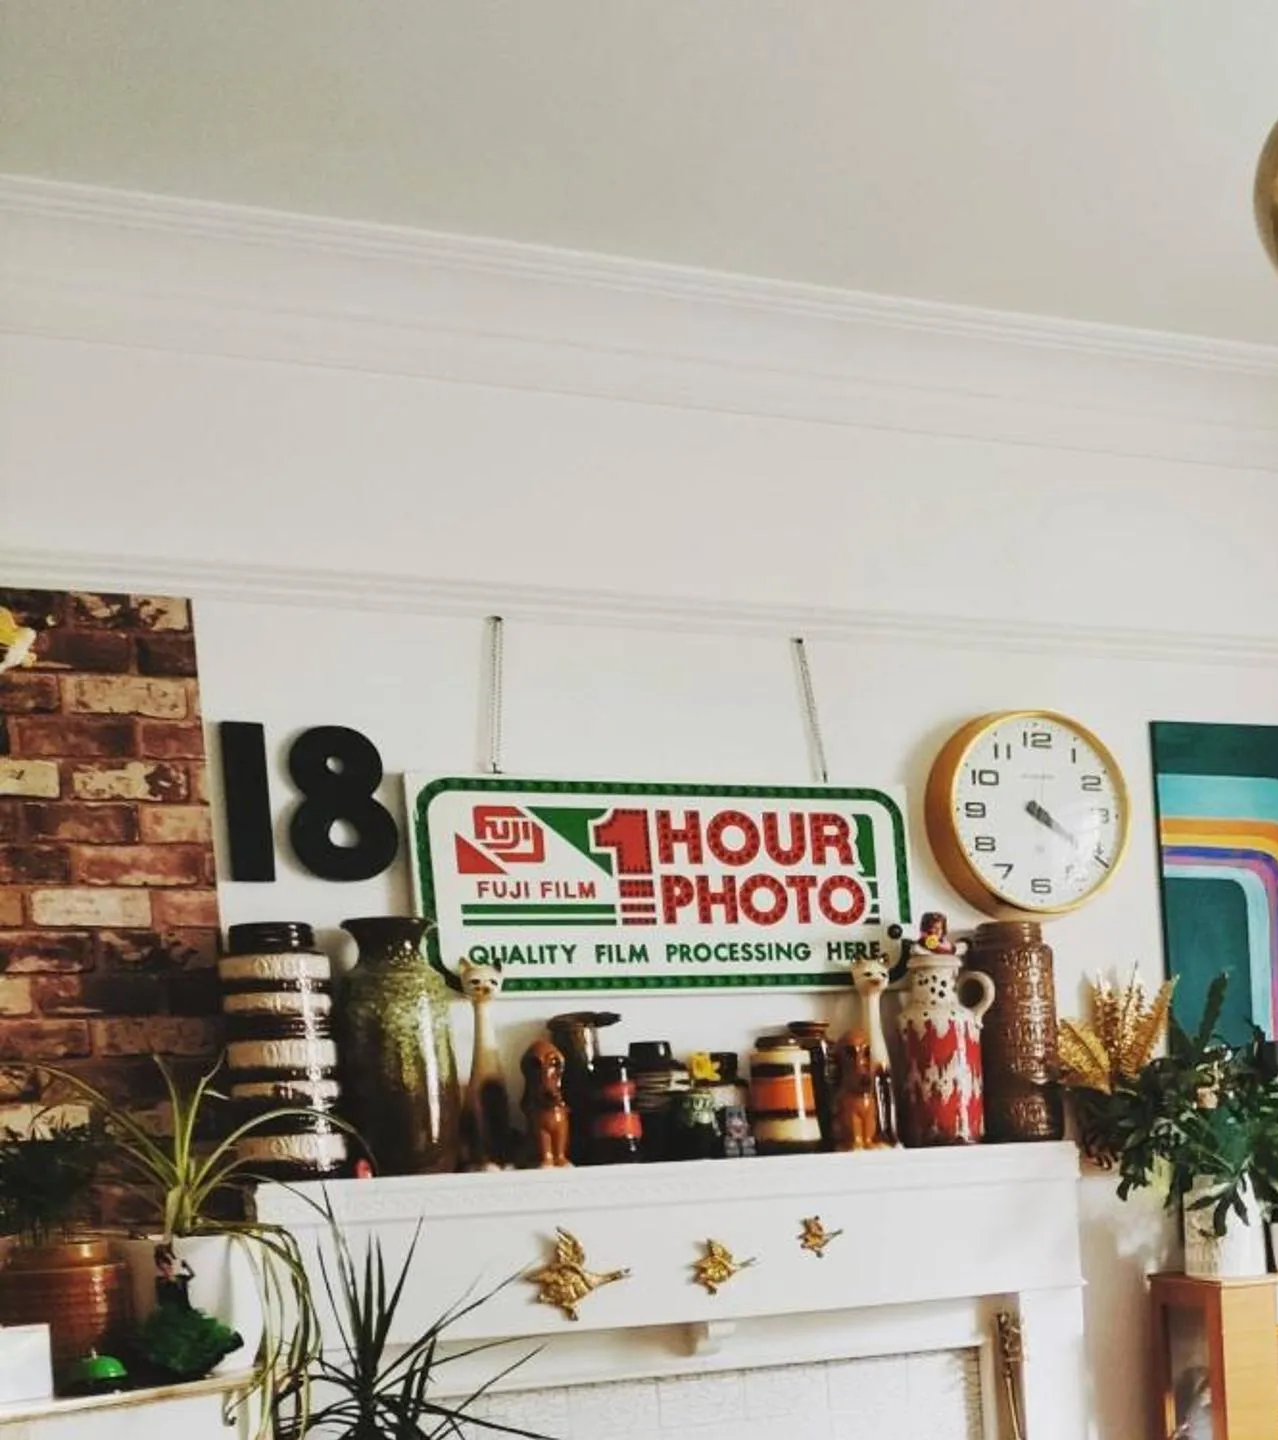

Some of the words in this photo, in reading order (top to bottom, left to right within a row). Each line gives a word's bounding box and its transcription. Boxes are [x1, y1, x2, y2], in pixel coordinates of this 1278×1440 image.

[1023, 731, 1052, 749] 12
[993, 743, 1012, 760] 11
[1071, 748, 1077, 764] 1
[971, 769, 1000, 786] 10
[1081, 775, 1103, 792] 2
[220, 720, 399, 884] 18
[965, 802, 987, 818] 9
[1092, 808, 1110, 824] 3
[594, 808, 653, 874] 1
[655, 809, 855, 867] HOUR
[975, 836, 996, 852] 8
[992, 863, 1014, 880] 7
[476, 881, 530, 899] FUJI
[540, 881, 597, 899] FILM
[1031, 879, 1051, 894] 6
[660, 873, 867, 926] PHOTO
[468, 944, 577, 965] QUALITY
[595, 944, 650, 964] FILM
[665, 942, 812, 963] PROCESSING
[826, 940, 881, 962] HERE
